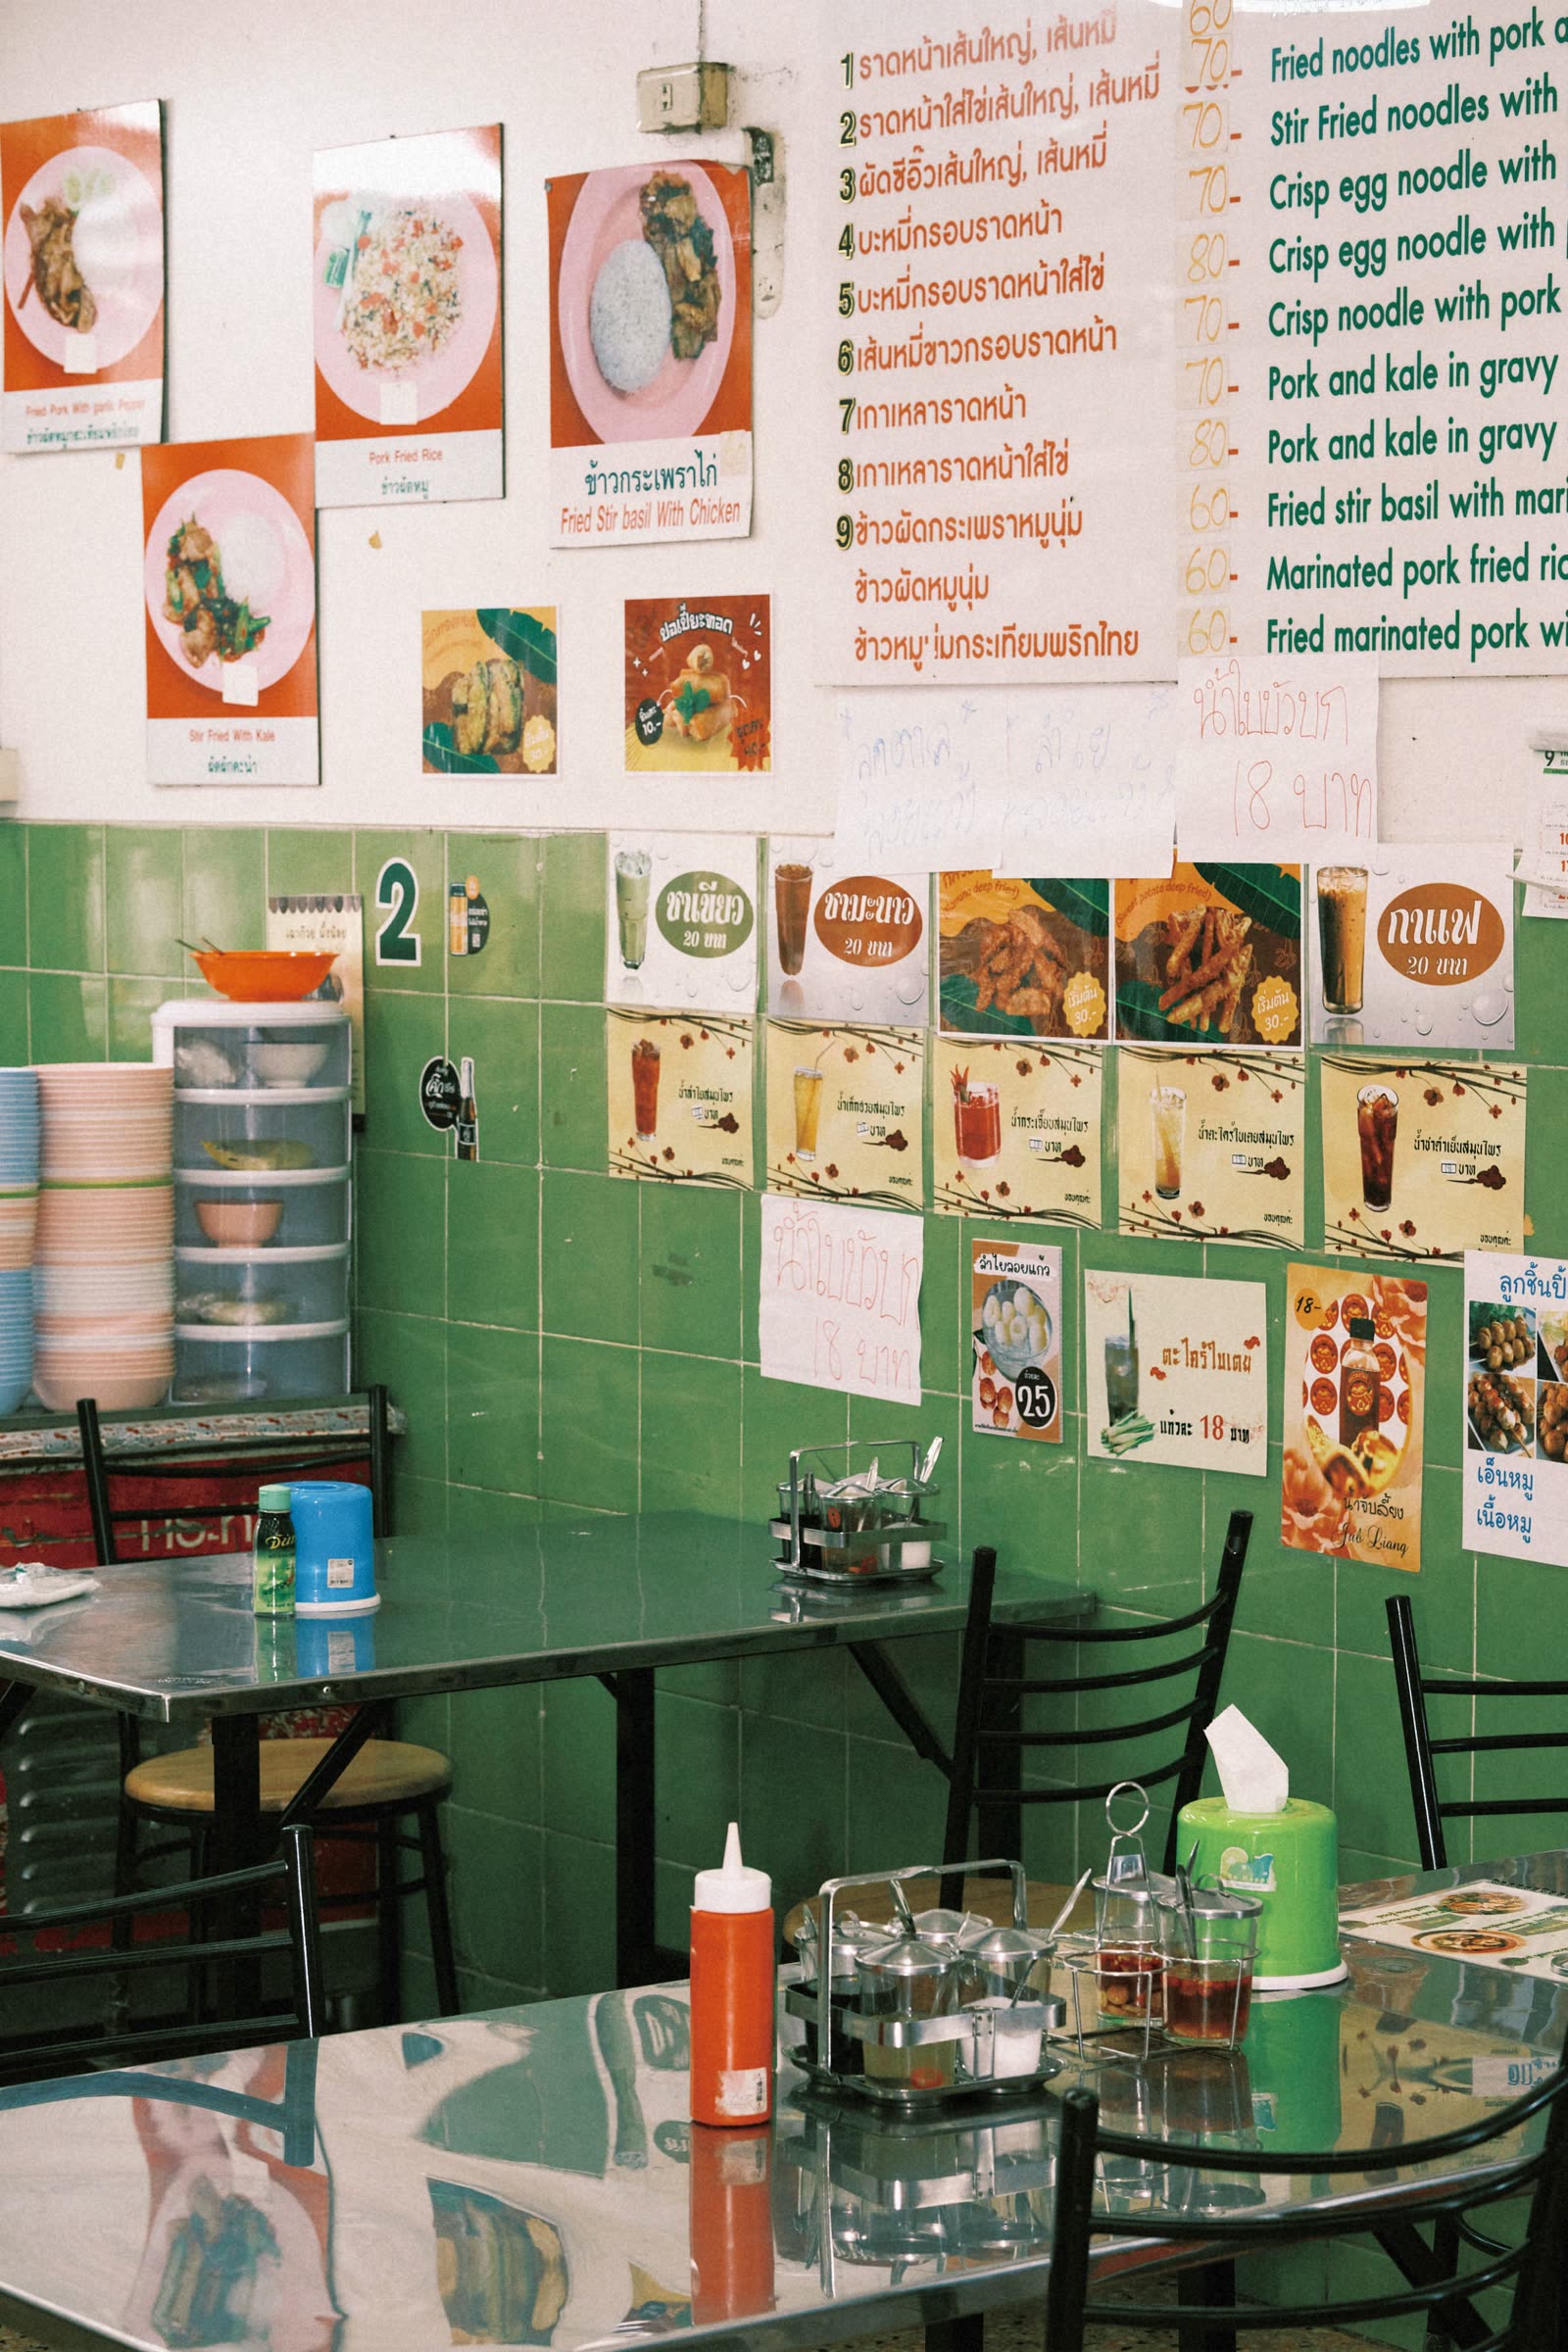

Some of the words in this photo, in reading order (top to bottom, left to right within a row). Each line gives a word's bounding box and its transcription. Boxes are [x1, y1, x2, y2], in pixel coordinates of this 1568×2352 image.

[1272, 36, 1324, 83] Fried
[1332, 26, 1420, 74] noodles
[1429, 15, 1480, 60] with
[1490, 5, 1545, 67] pork
[840, 52, 854, 89] 1
[840, 111, 857, 148] 2
[1090, 50, 1160, 108] เส้นหมี่
[1270, 108, 1309, 146] Stir
[1318, 94, 1377, 140] Fried
[1388, 83, 1490, 131] noodles
[1499, 72, 1558, 118] with
[839, 167, 856, 204] 3
[1038, 120, 1107, 175] เส้นหมี่
[1269, 172, 1330, 219] Crisp
[1339, 172, 1388, 213] egg
[1397, 148, 1488, 195] noodle
[1498, 139, 1556, 184] with
[838, 223, 855, 260] 4
[858, 199, 1062, 255] บะหมี่กรอบราดหน้า
[1269, 235, 1329, 282] Crisp
[1339, 237, 1387, 278] egg
[1397, 215, 1487, 262] noodle
[1497, 207, 1555, 251] with
[838, 282, 855, 318] 5
[858, 252, 1105, 314] บะหมี่กรอบราดหน้าใส่ไข่
[1268, 300, 1328, 347] Crisp
[1338, 286, 1424, 331] noodle
[1435, 279, 1490, 322] with
[1501, 273, 1561, 331] pork
[838, 339, 854, 376] 6
[858, 315, 1117, 371] เส้นหมี่ขาวกรอบราดหน้า
[1268, 359, 1320, 400] Pork
[1329, 354, 1375, 396] and
[1386, 350, 1438, 392] kale
[1448, 350, 1470, 389] in
[1480, 354, 1559, 399] gravy
[839, 398, 856, 434] 7
[857, 383, 1026, 429] เกาเหลาราดหน้า
[369, 452, 390, 465] Pork
[395, 450, 418, 463] Fried
[422, 448, 443, 462] Rice
[1268, 423, 1319, 464] Pork
[1328, 418, 1374, 461] and
[1385, 415, 1438, 457] kale
[1447, 416, 1469, 454] in
[1479, 421, 1558, 465] gravy
[585, 449, 717, 496] ข้าวกระเพราไก่
[838, 457, 854, 494] 8
[857, 438, 1068, 488] เกาเหลาราดหน้าใส่ไข่
[561, 507, 591, 534] Fried
[596, 505, 618, 532] Stir
[622, 502, 652, 531] basil
[657, 500, 684, 528] With
[690, 497, 740, 526] Chicken
[836, 514, 854, 552] 9
[855, 498, 1083, 549] ข้าวผัดกระเพราหมูนุ่ม
[1268, 486, 1325, 527] Fried
[1335, 487, 1372, 524] stir
[1381, 480, 1439, 522] basil
[1449, 476, 1504, 518] with
[855, 563, 989, 612] ข้าวผัดหมูนุ่ม
[1266, 547, 1393, 591] Marinated
[1403, 544, 1460, 599] pork
[1470, 541, 1529, 584] fried
[1267, 613, 1325, 653] Fried
[1334, 609, 1460, 653] marinated
[1471, 608, 1530, 662] pork
[1234, 760, 1273, 837] 18
[1294, 772, 1372, 839] บาท
[376, 858, 420, 965] 2
[666, 881, 745, 925] ชาเขียว
[824, 893, 915, 926] ชามะนาว
[1388, 901, 1483, 946] กาแฟ
[683, 930, 700, 948] 20
[704, 933, 727, 950] บาท
[844, 938, 861, 956] 20
[867, 940, 893, 957] บาท
[1406, 956, 1429, 976] 20
[1437, 957, 1468, 977] บาท
[1257, 988, 1290, 1014] เริ่มต้น
[1264, 1014, 1290, 1032] 30.-
[870, 1125, 886, 1137] บาท
[1045, 1142, 1061, 1152] บาท
[1248, 1156, 1264, 1168] บาท
[1458, 1163, 1476, 1175] บาท
[980, 1252, 1051, 1276] ลำไยลอยแก้ว
[813, 1316, 842, 1382] 18
[857, 1339, 911, 1390] บาท
[1162, 1336, 1252, 1375] ตะไคร้ใบเตย
[1018, 1385, 1051, 1417] 25
[1158, 1408, 1193, 1436] แก้วละ
[1200, 1414, 1224, 1441] 18
[1231, 1428, 1250, 1444] บาท
[1477, 1457, 1535, 1501] เอ็นหมู
[1368, 1525, 1409, 1558] Liang
[1477, 1494, 1533, 1544] เนื้อหมู
